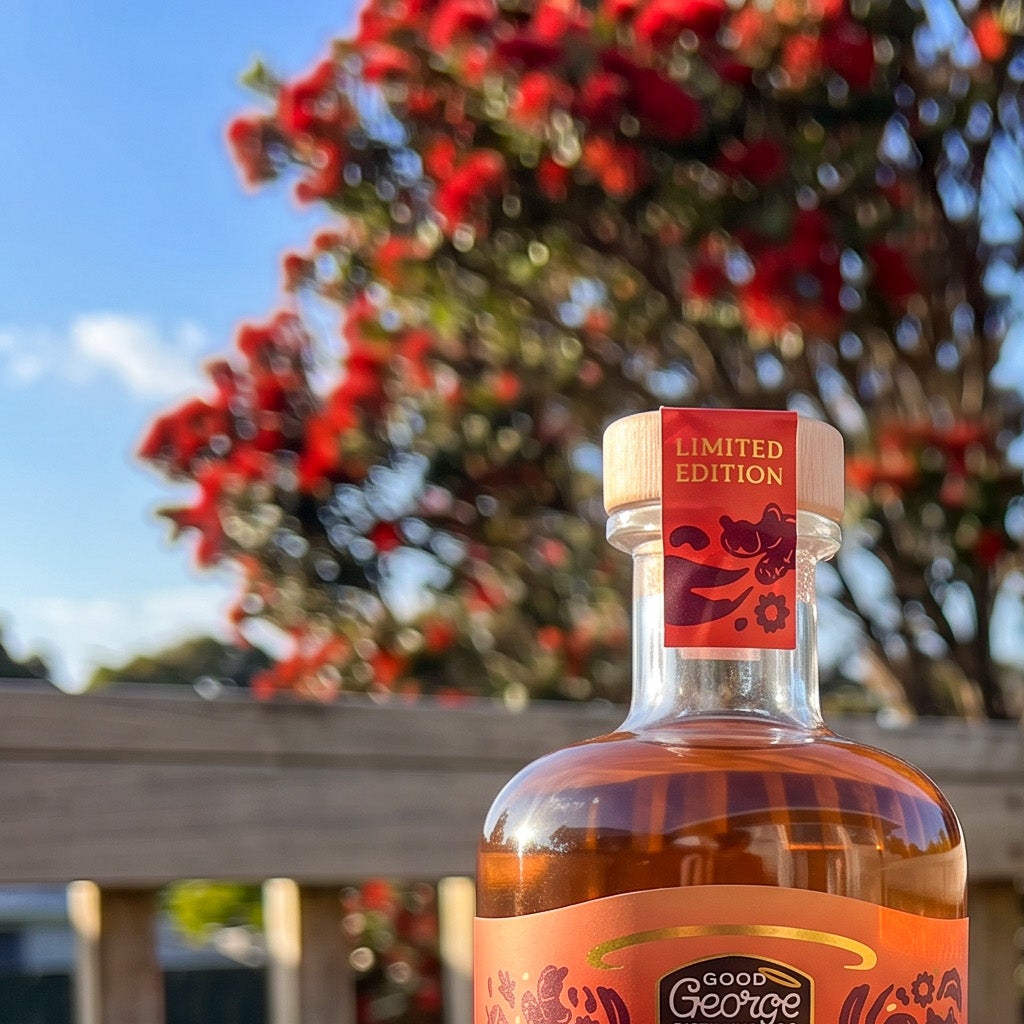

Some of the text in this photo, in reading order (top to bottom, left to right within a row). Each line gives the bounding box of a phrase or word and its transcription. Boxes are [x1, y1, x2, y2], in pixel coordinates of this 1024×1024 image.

[675, 437, 784, 460] LIMITED
[675, 463, 784, 486] EDITION
[703, 972, 767, 986] GOOD
